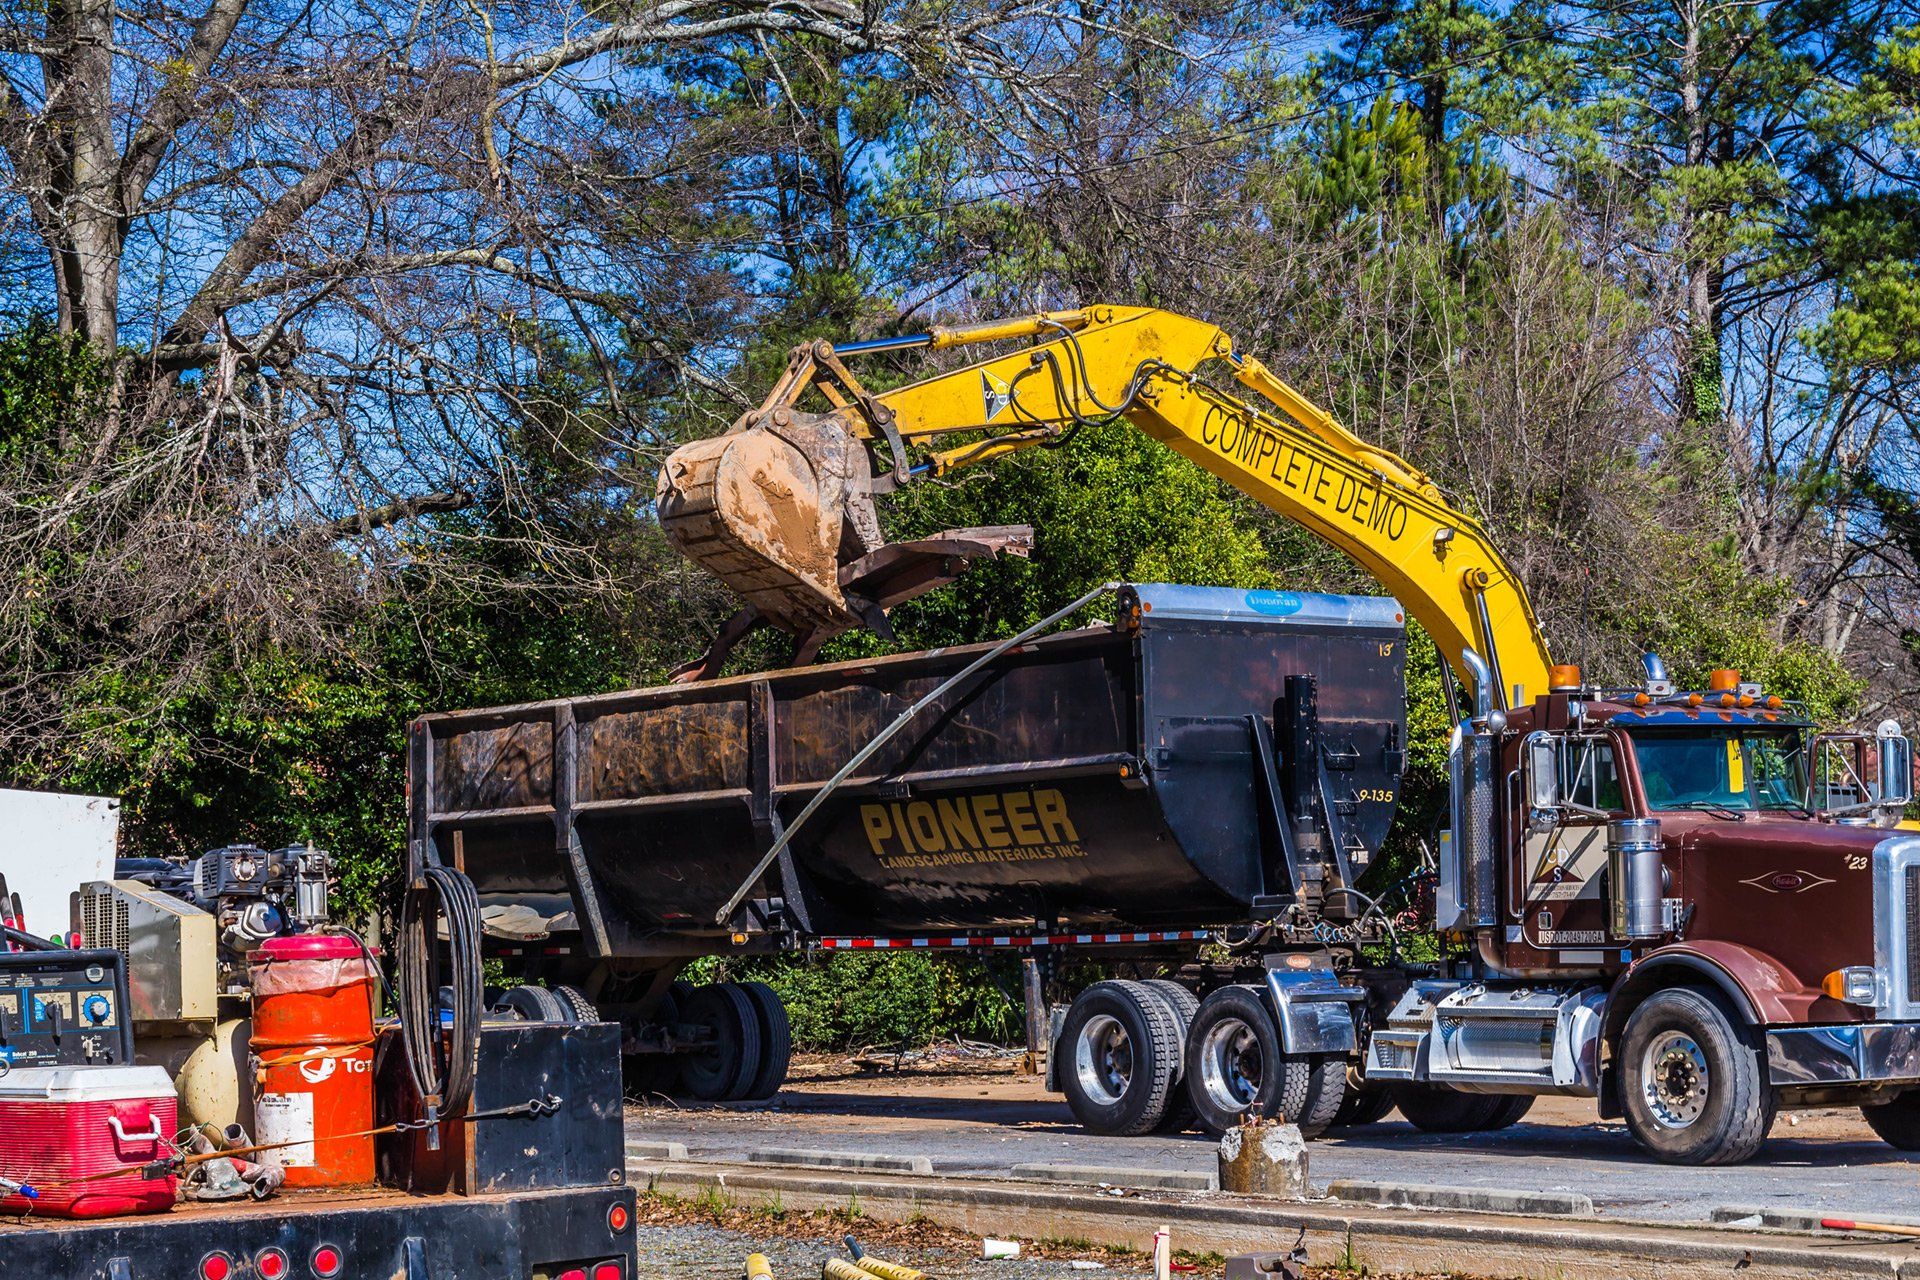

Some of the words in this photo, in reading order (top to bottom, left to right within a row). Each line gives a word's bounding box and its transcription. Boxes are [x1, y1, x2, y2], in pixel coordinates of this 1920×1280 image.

[1202, 404, 1335, 505] COMPLETE
[1335, 473, 1408, 541] DEMO
[1250, 595, 1298, 607] Donovan
[1360, 789, 1394, 802] 9-135
[860, 788, 1080, 856] PIONEER
[879, 851, 974, 869] LANDSCAPING
[975, 846, 1057, 864] MATERIALS
[1058, 844, 1089, 859] INC.
[1844, 854, 1868, 870] #23
